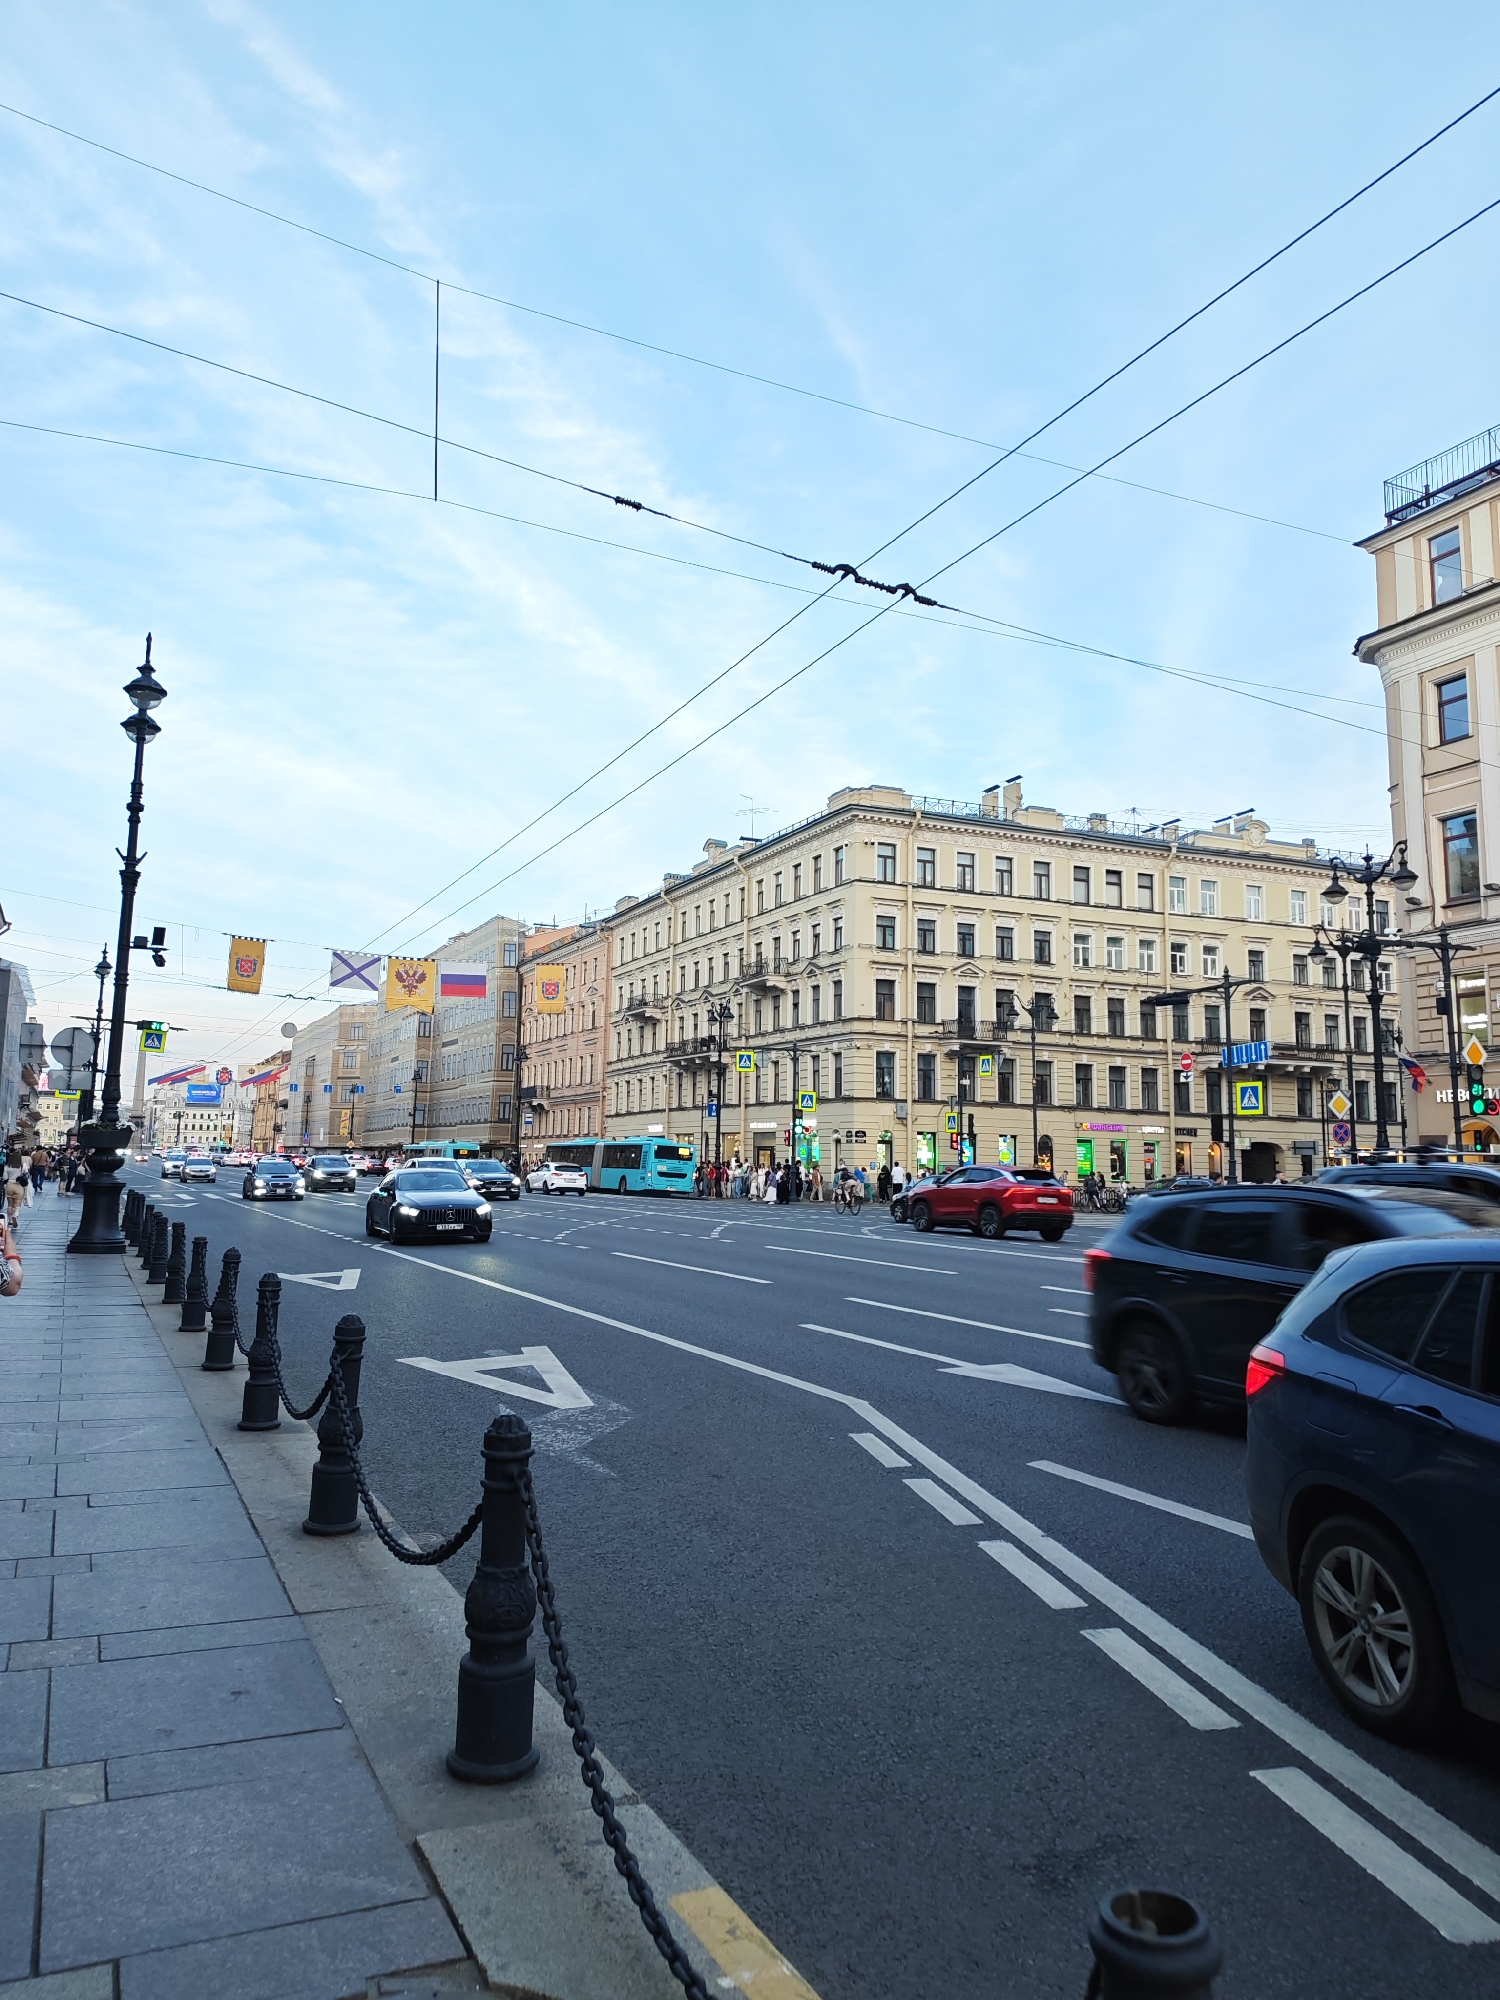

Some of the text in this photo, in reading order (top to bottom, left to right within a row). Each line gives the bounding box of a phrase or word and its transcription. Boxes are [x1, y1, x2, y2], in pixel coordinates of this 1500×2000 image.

[1436, 1087, 1500, 1103] НЕВИ
[1471, 1083, 1483, 1096] 21
[1091, 1123, 1124, 1132] Фантазия
